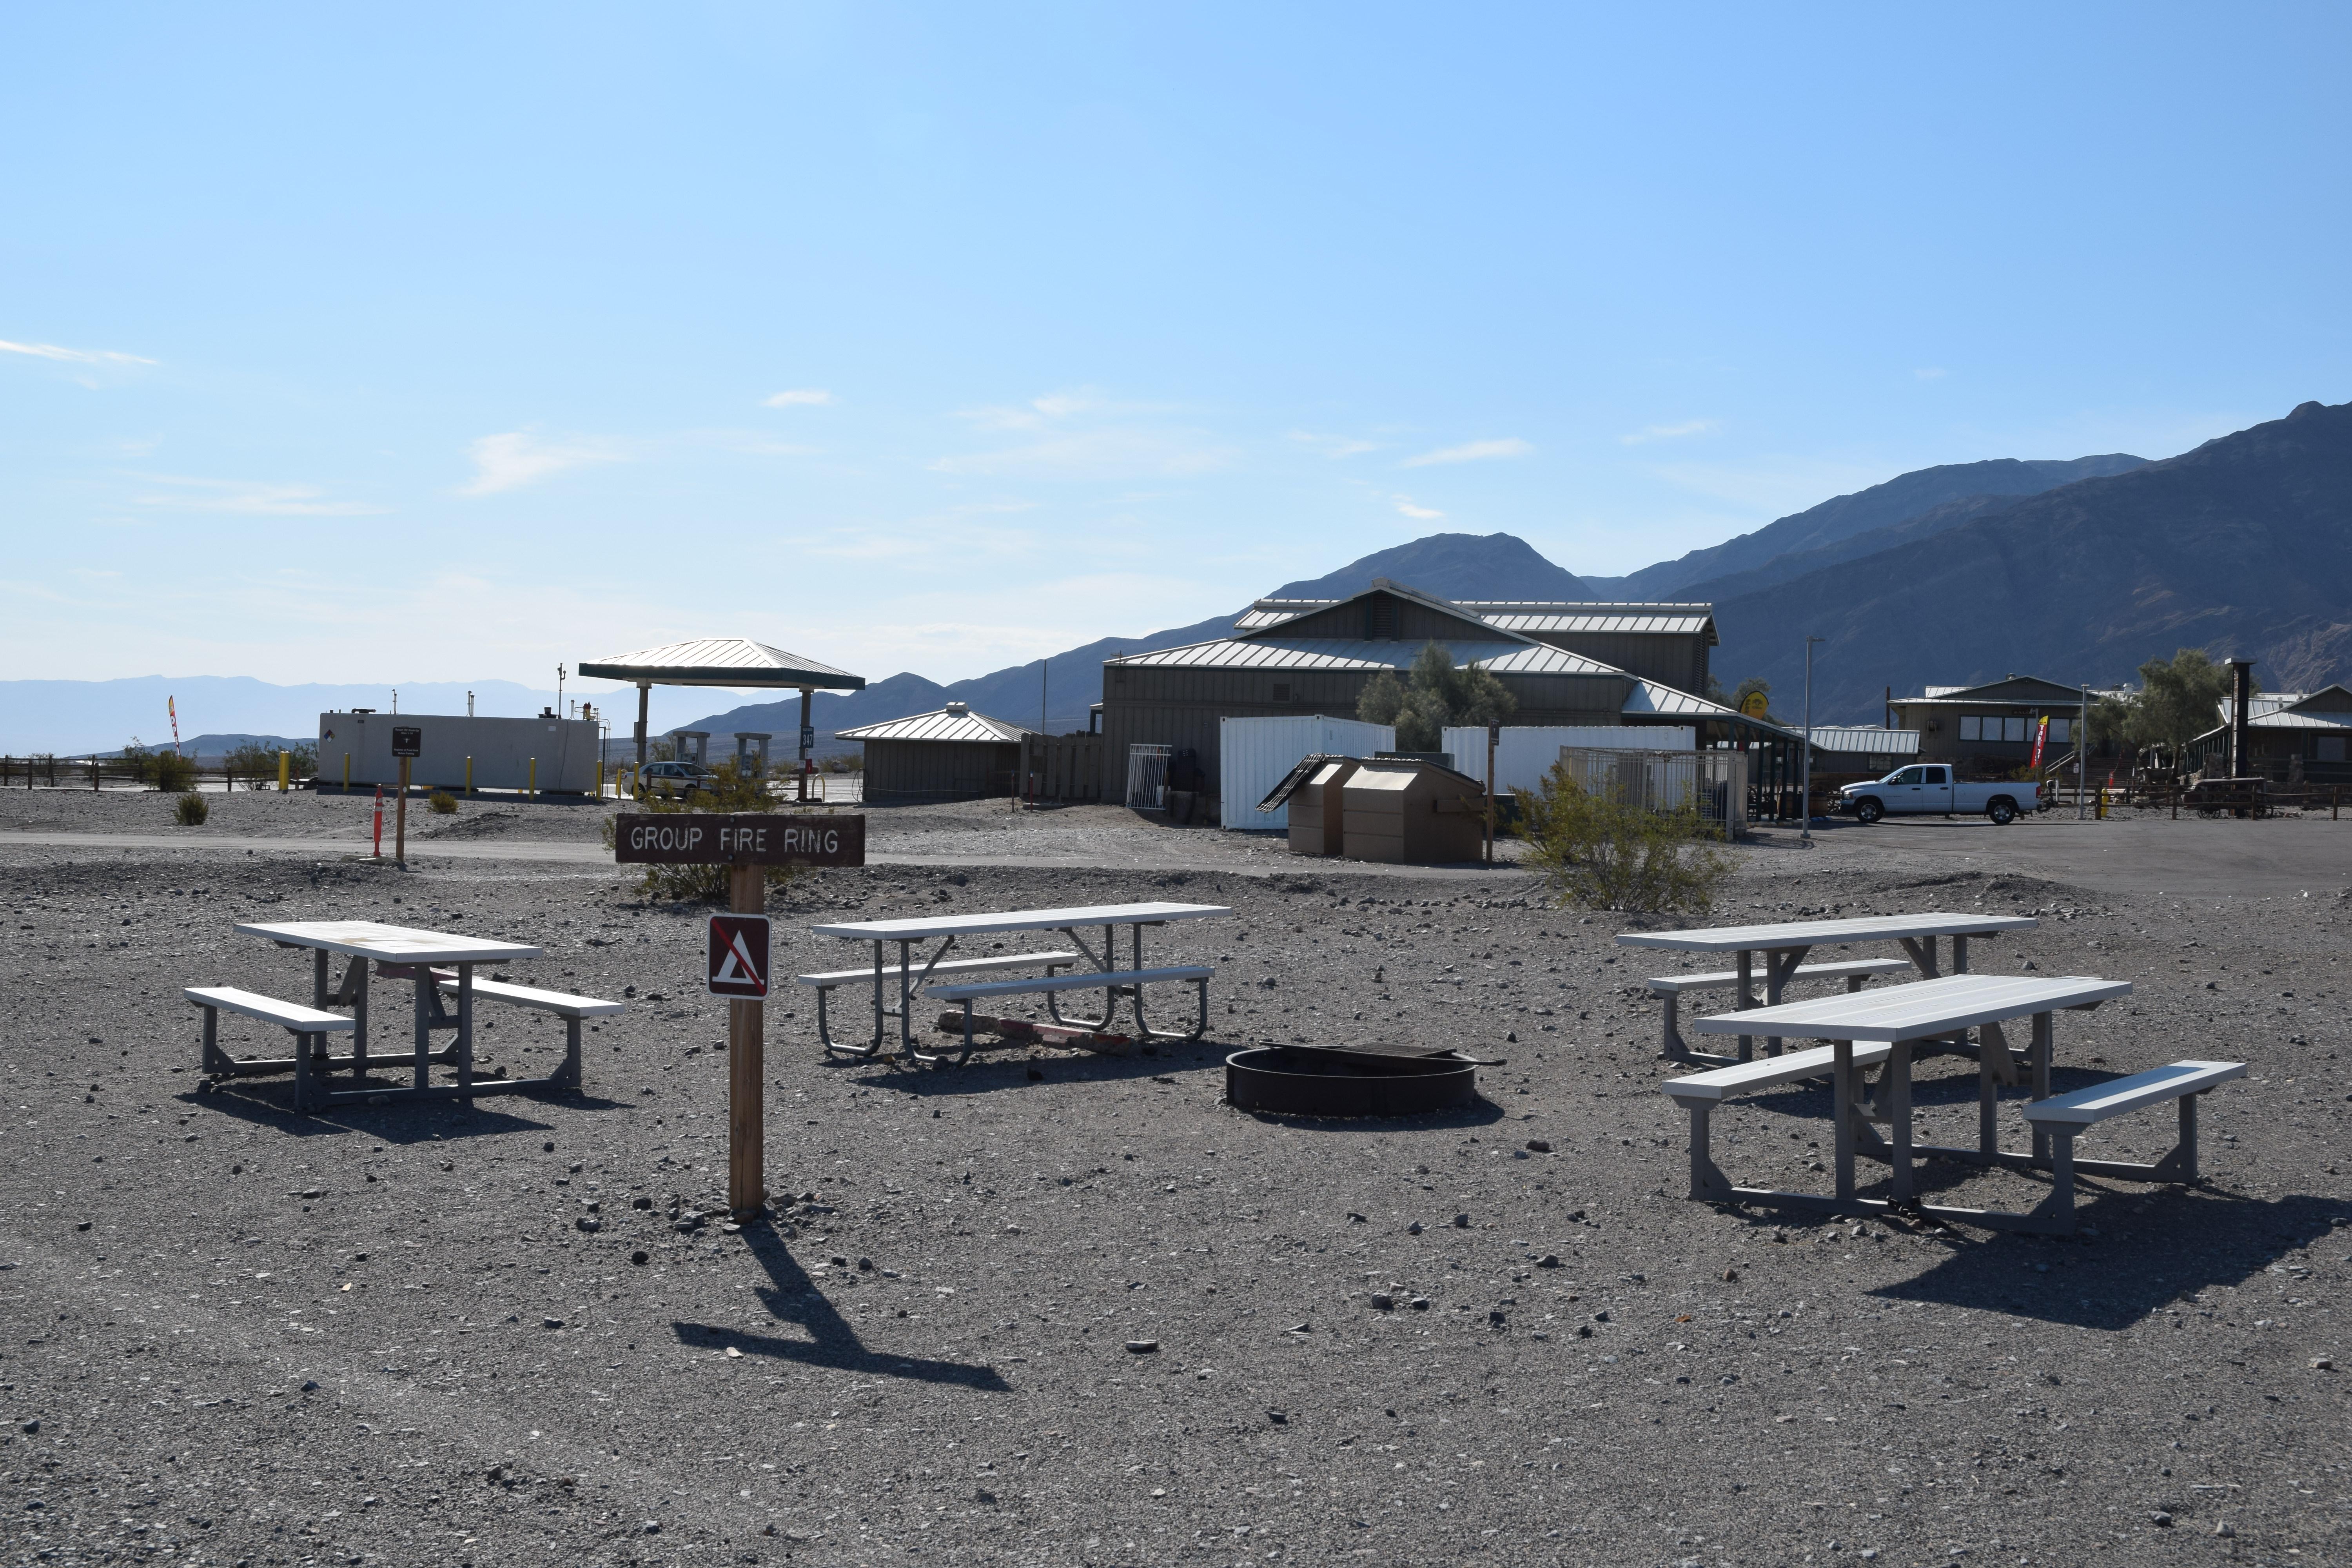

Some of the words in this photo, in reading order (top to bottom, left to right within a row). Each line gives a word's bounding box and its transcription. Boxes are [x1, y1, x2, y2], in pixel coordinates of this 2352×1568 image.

[803, 734, 813, 745] 347
[631, 826, 702, 850] GROUP
[720, 828, 767, 852] FIRE
[784, 829, 838, 853] RING
